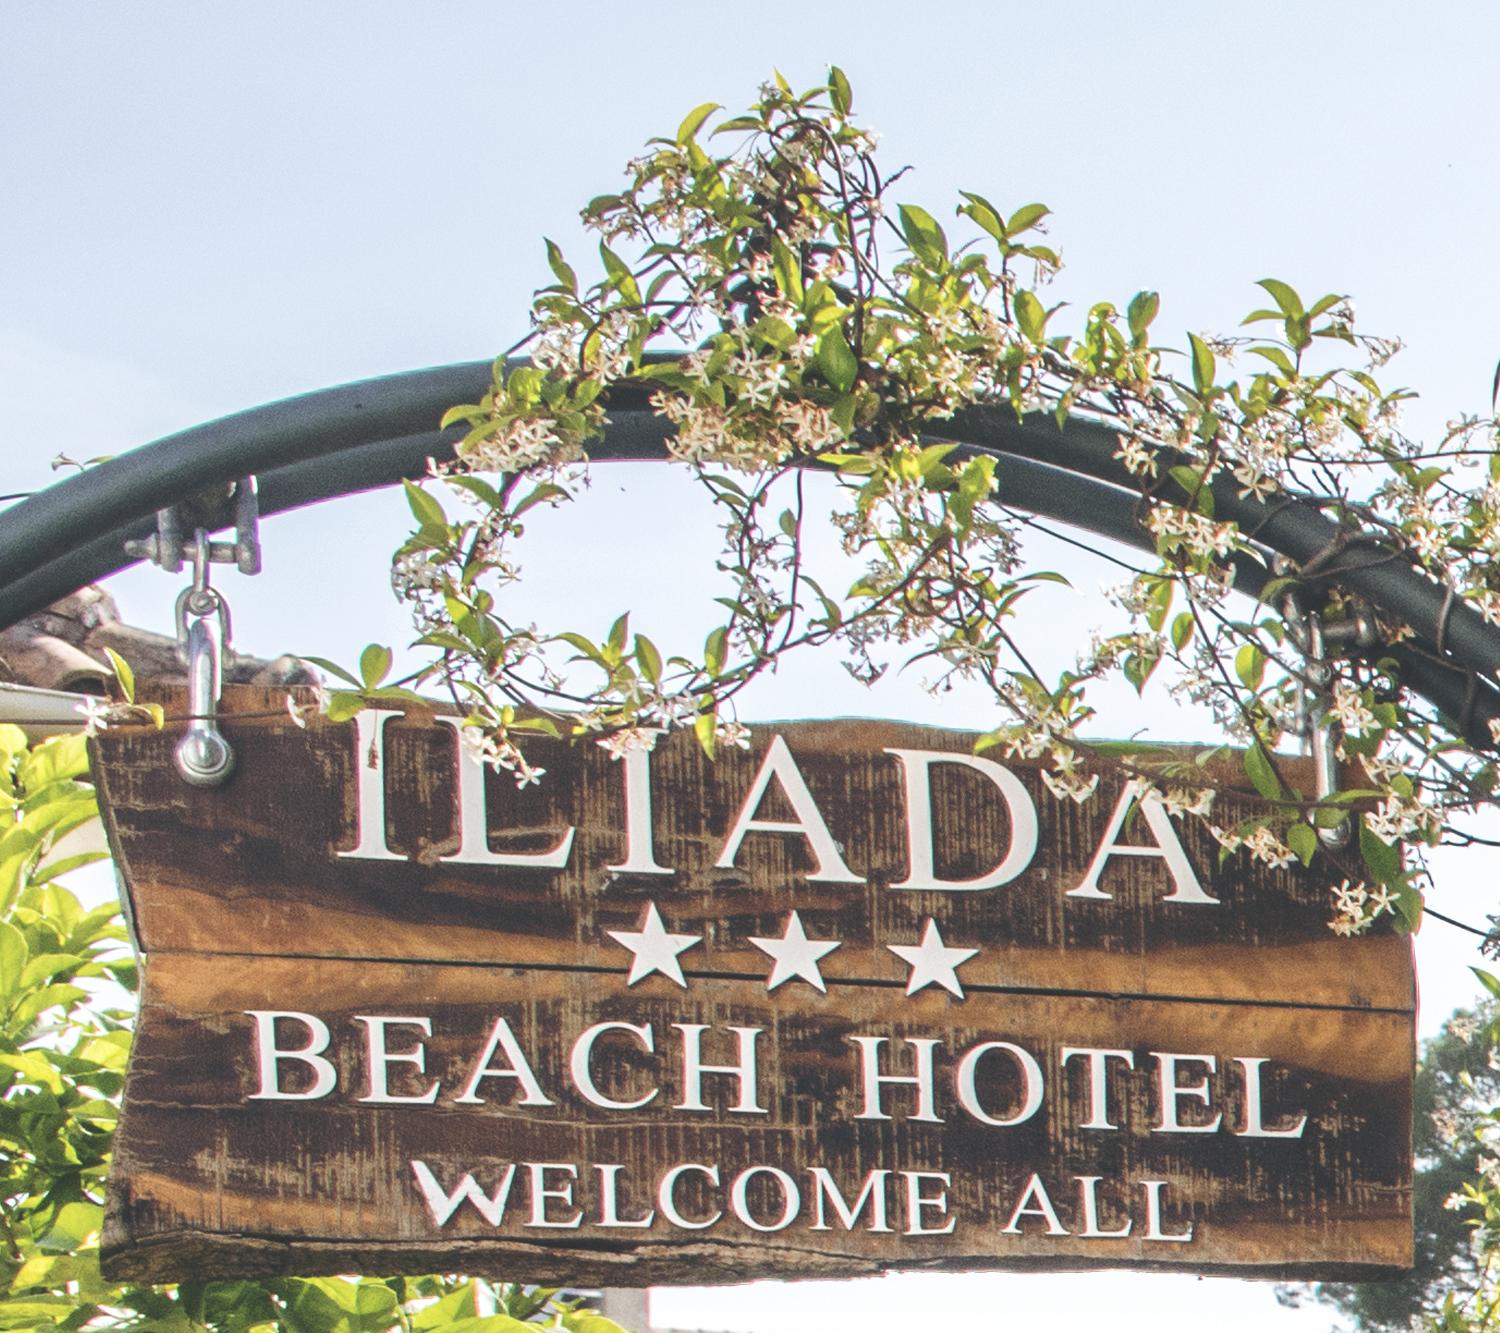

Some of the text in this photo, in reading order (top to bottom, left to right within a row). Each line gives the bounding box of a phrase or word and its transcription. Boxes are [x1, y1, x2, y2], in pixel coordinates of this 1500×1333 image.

[336, 709, 1220, 904] ILIADA
[244, 1010, 1308, 1139] BEACH HOTEL
[409, 1160, 1194, 1242] WELCOME ALL
